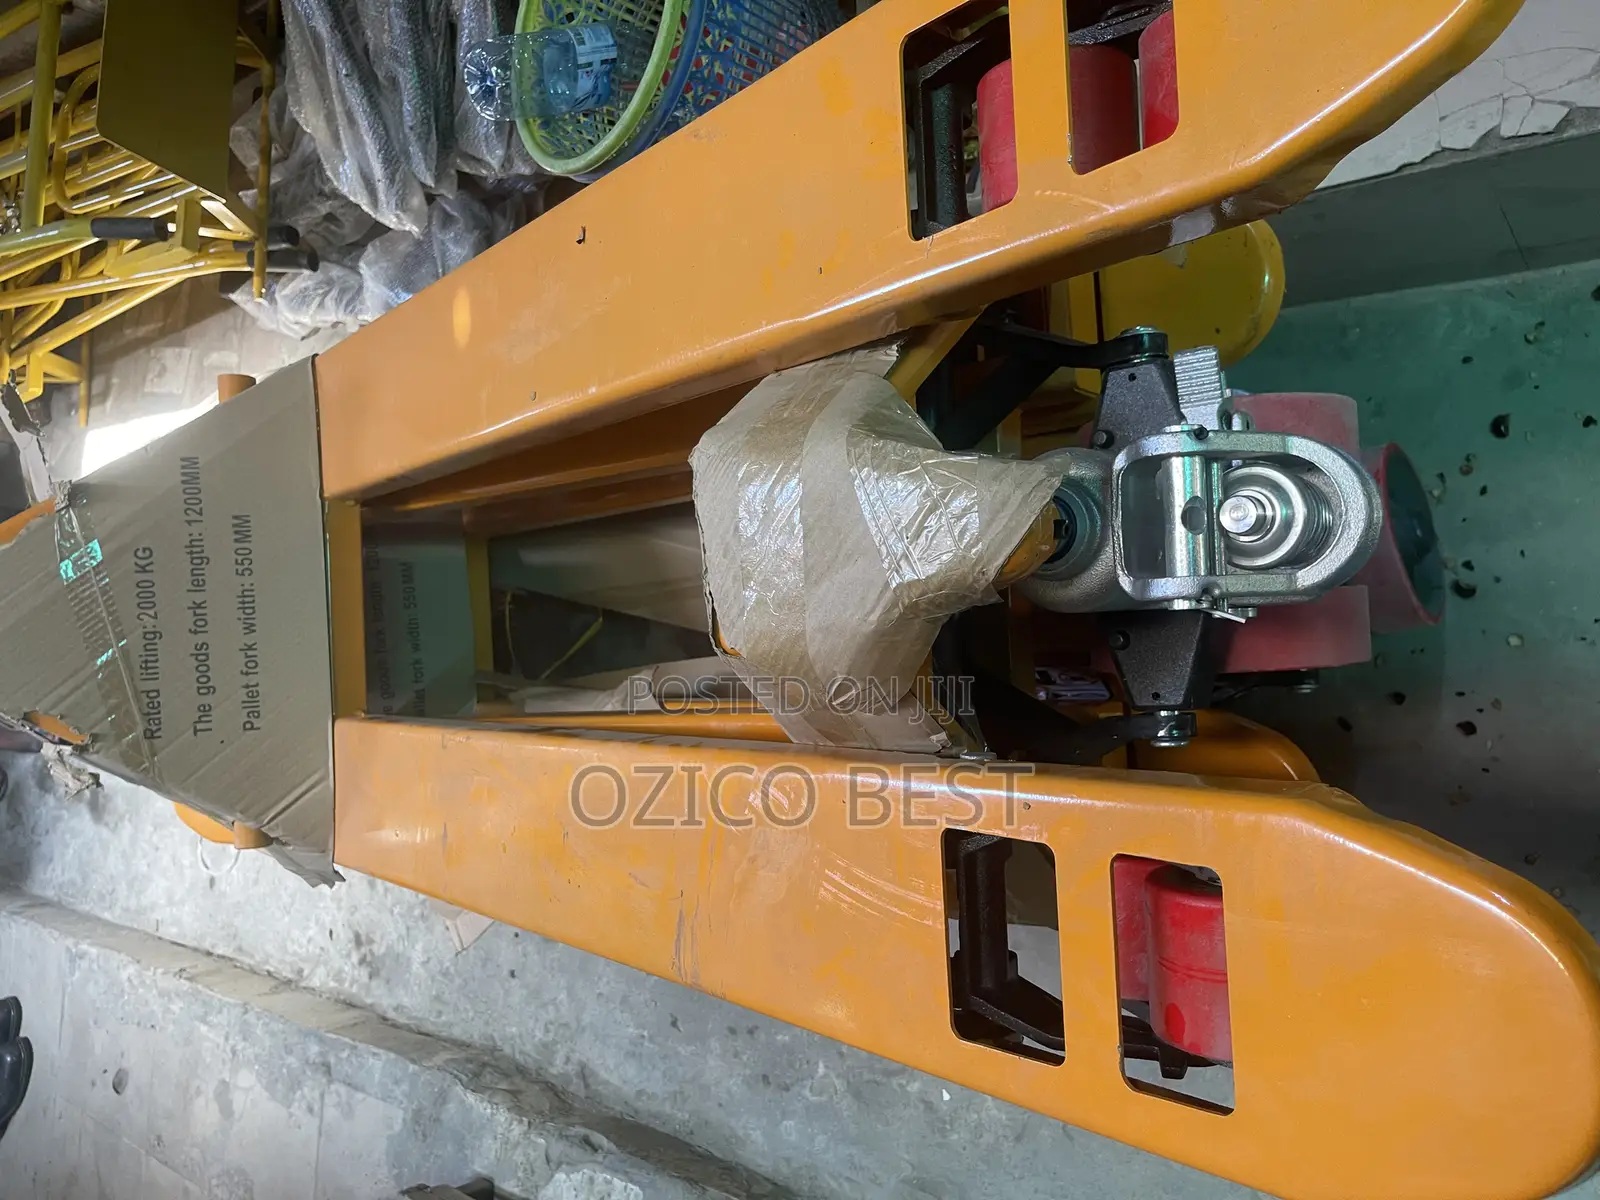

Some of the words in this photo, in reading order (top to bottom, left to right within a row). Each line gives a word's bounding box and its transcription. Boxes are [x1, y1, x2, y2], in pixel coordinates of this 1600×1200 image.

[180, 457, 203, 527] 1200MM
[134, 547, 154, 573] KG
[184, 533, 210, 592] length:
[187, 600, 208, 635] fork
[237, 582, 257, 635] width:
[190, 641, 216, 696] goods
[239, 642, 259, 675] fork
[141, 688, 162, 739] Rated
[193, 703, 212, 737] The
[241, 682, 260, 732] Pallet
